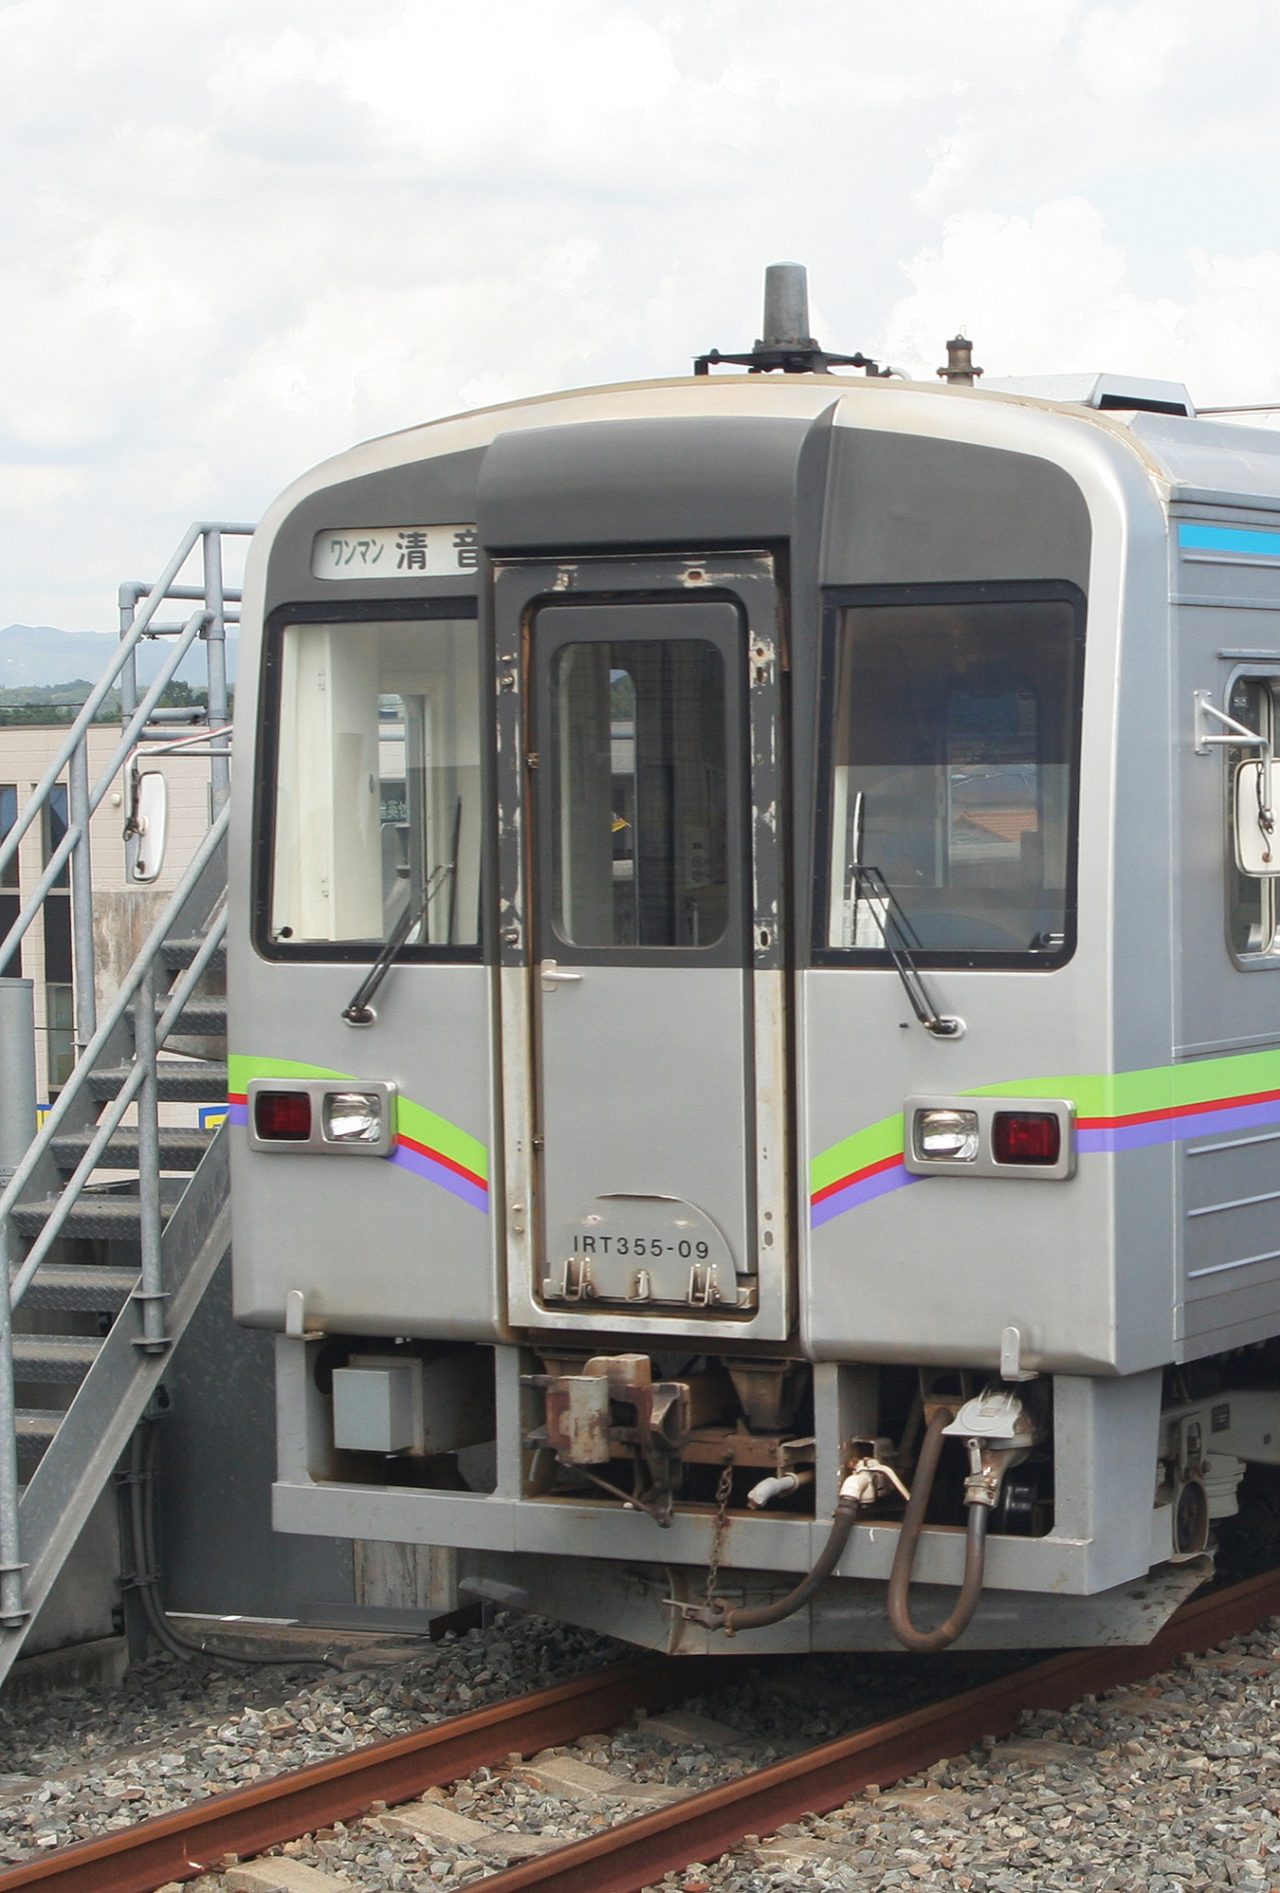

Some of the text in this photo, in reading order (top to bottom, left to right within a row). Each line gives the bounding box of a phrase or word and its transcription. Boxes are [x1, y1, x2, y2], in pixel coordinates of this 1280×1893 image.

[330, 538, 385, 567] ワンマン
[573, 1235, 710, 1260] IRT355-09
